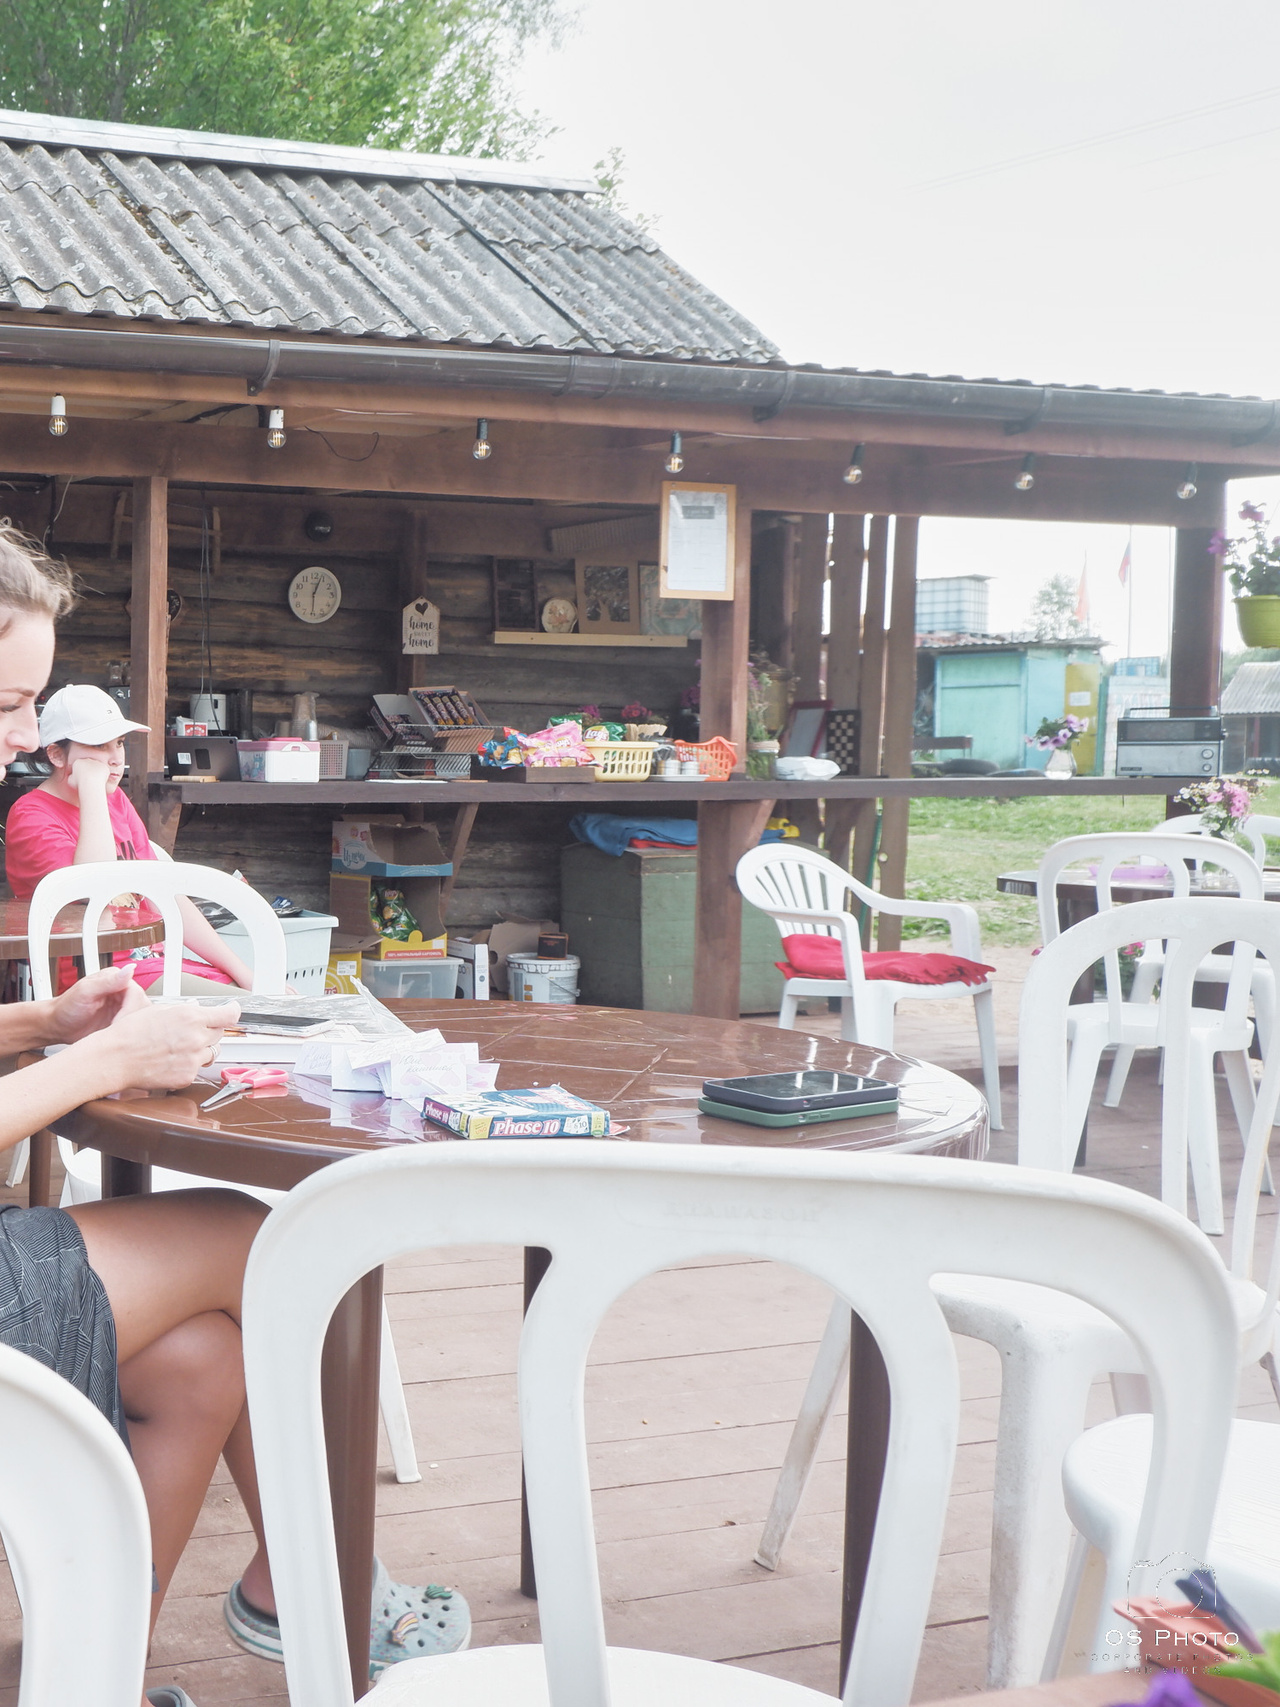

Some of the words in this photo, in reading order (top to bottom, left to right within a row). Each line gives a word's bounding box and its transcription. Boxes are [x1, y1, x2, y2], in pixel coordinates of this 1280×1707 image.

[409, 615, 435, 631] home
[408, 633, 434, 649] home
[492, 1118, 541, 1136] Phase
[542, 1118, 561, 1136] 10
